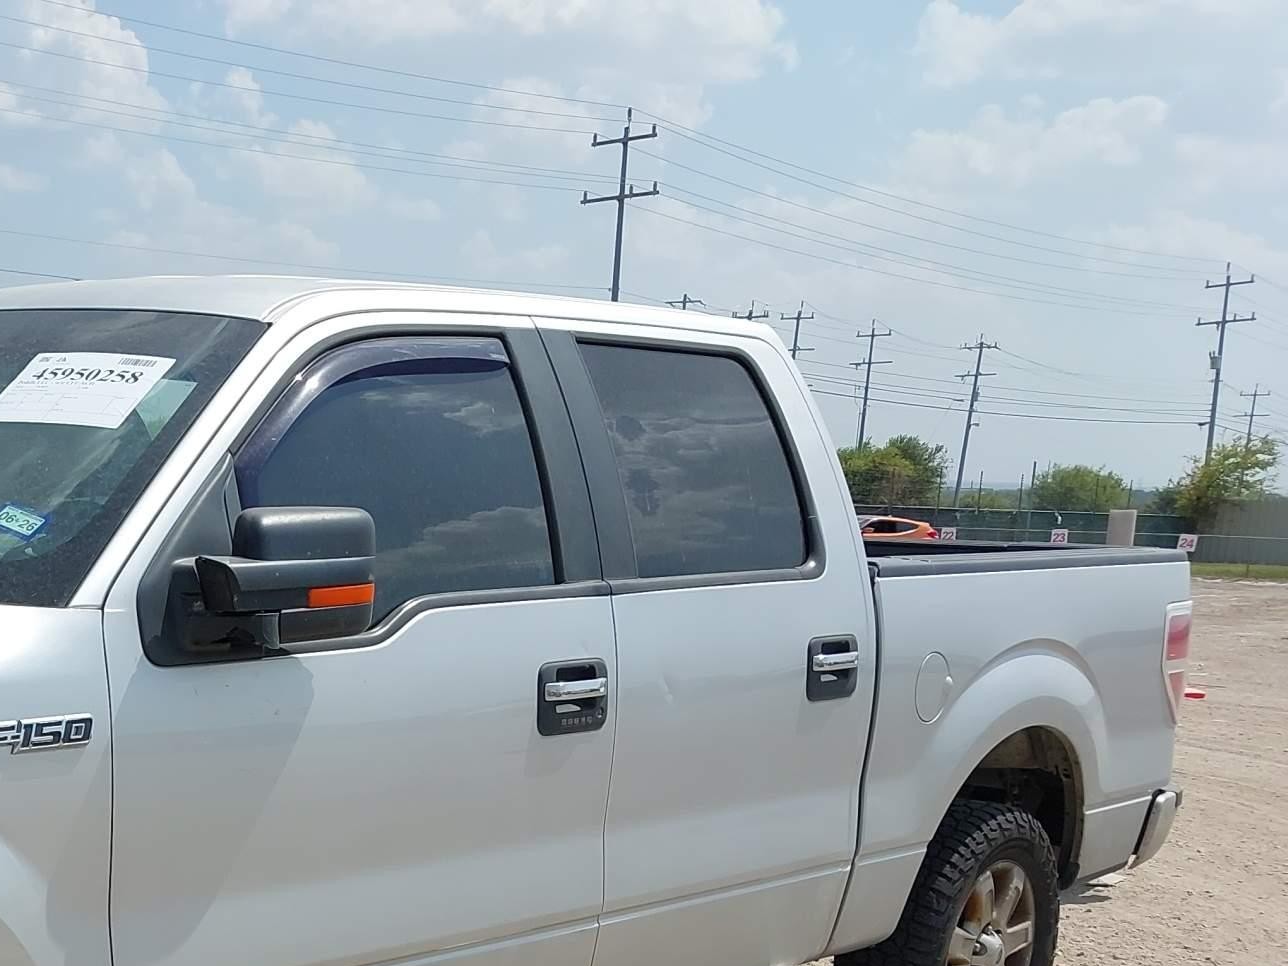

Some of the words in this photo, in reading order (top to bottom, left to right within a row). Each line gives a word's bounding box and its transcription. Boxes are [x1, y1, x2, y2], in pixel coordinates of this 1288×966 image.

[32, 367, 144, 384] 45950258
[17, 519, 38, 531] 26
[1053, 532, 1065, 542] 23
[1179, 538, 1194, 548] 24
